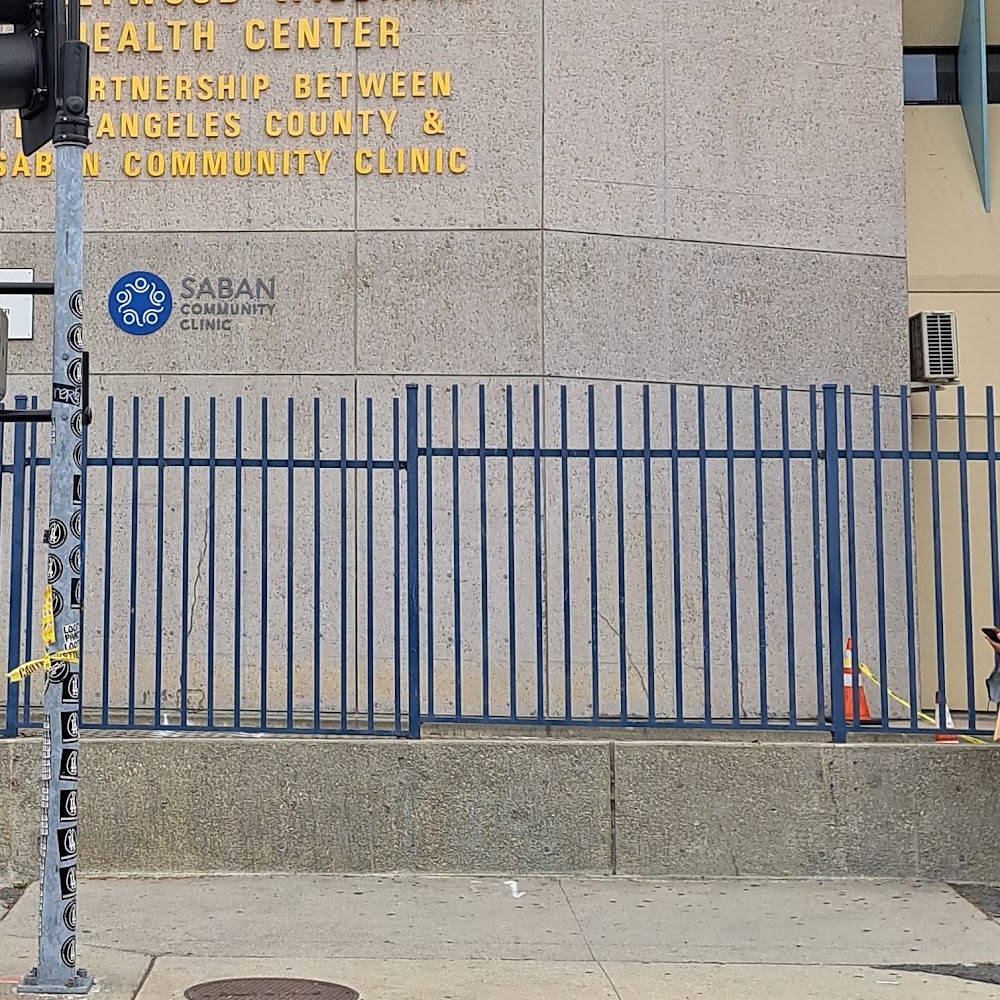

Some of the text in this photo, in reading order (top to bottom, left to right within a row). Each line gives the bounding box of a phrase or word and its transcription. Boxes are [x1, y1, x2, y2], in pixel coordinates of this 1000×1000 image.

[245, 16, 399, 50] CENTER
[90, 71, 450, 101] RTNERSHIP BETWEEN
[97, 108, 444, 138] ANGELES COUNTY &
[124, 148, 332, 177] COMMUNITY
[356, 146, 467, 174] CLINIC
[181, 276, 276, 299] SABAN
[180, 303, 276, 315] COMMUNITY
[180, 318, 232, 330] CLINIC
